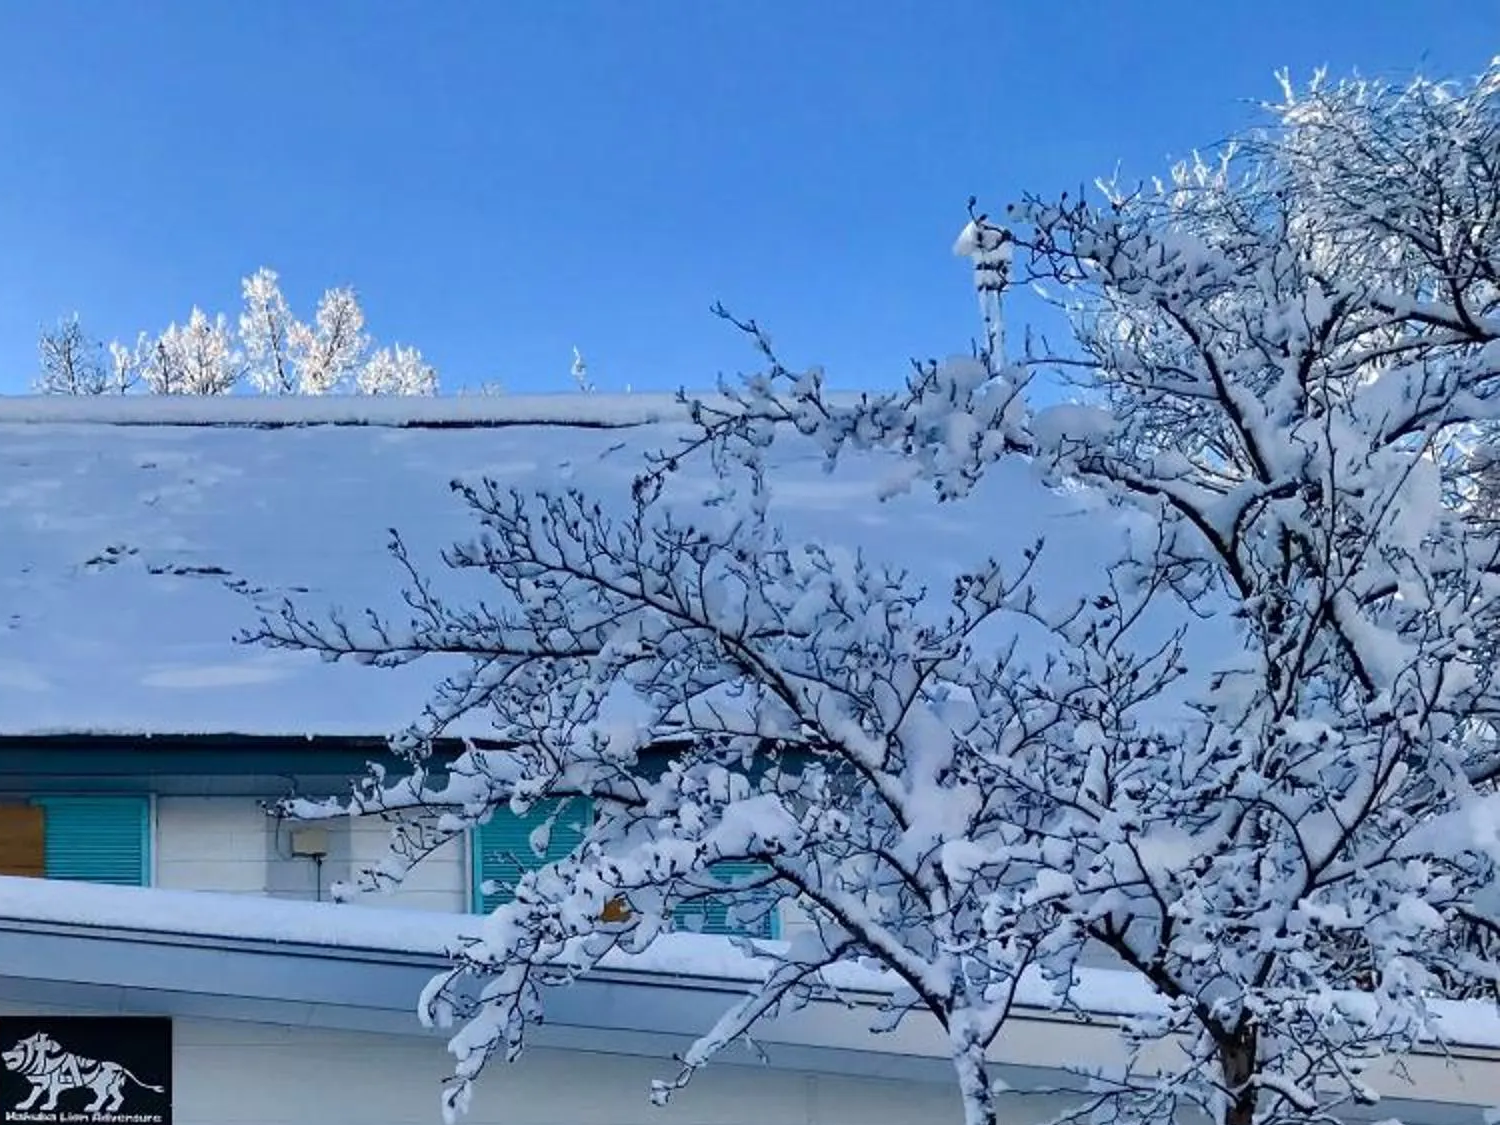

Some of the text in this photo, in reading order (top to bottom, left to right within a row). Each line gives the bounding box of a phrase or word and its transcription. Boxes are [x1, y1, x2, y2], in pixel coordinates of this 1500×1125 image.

[5, 1111, 163, 1123] Hakuba Lion Adventure
